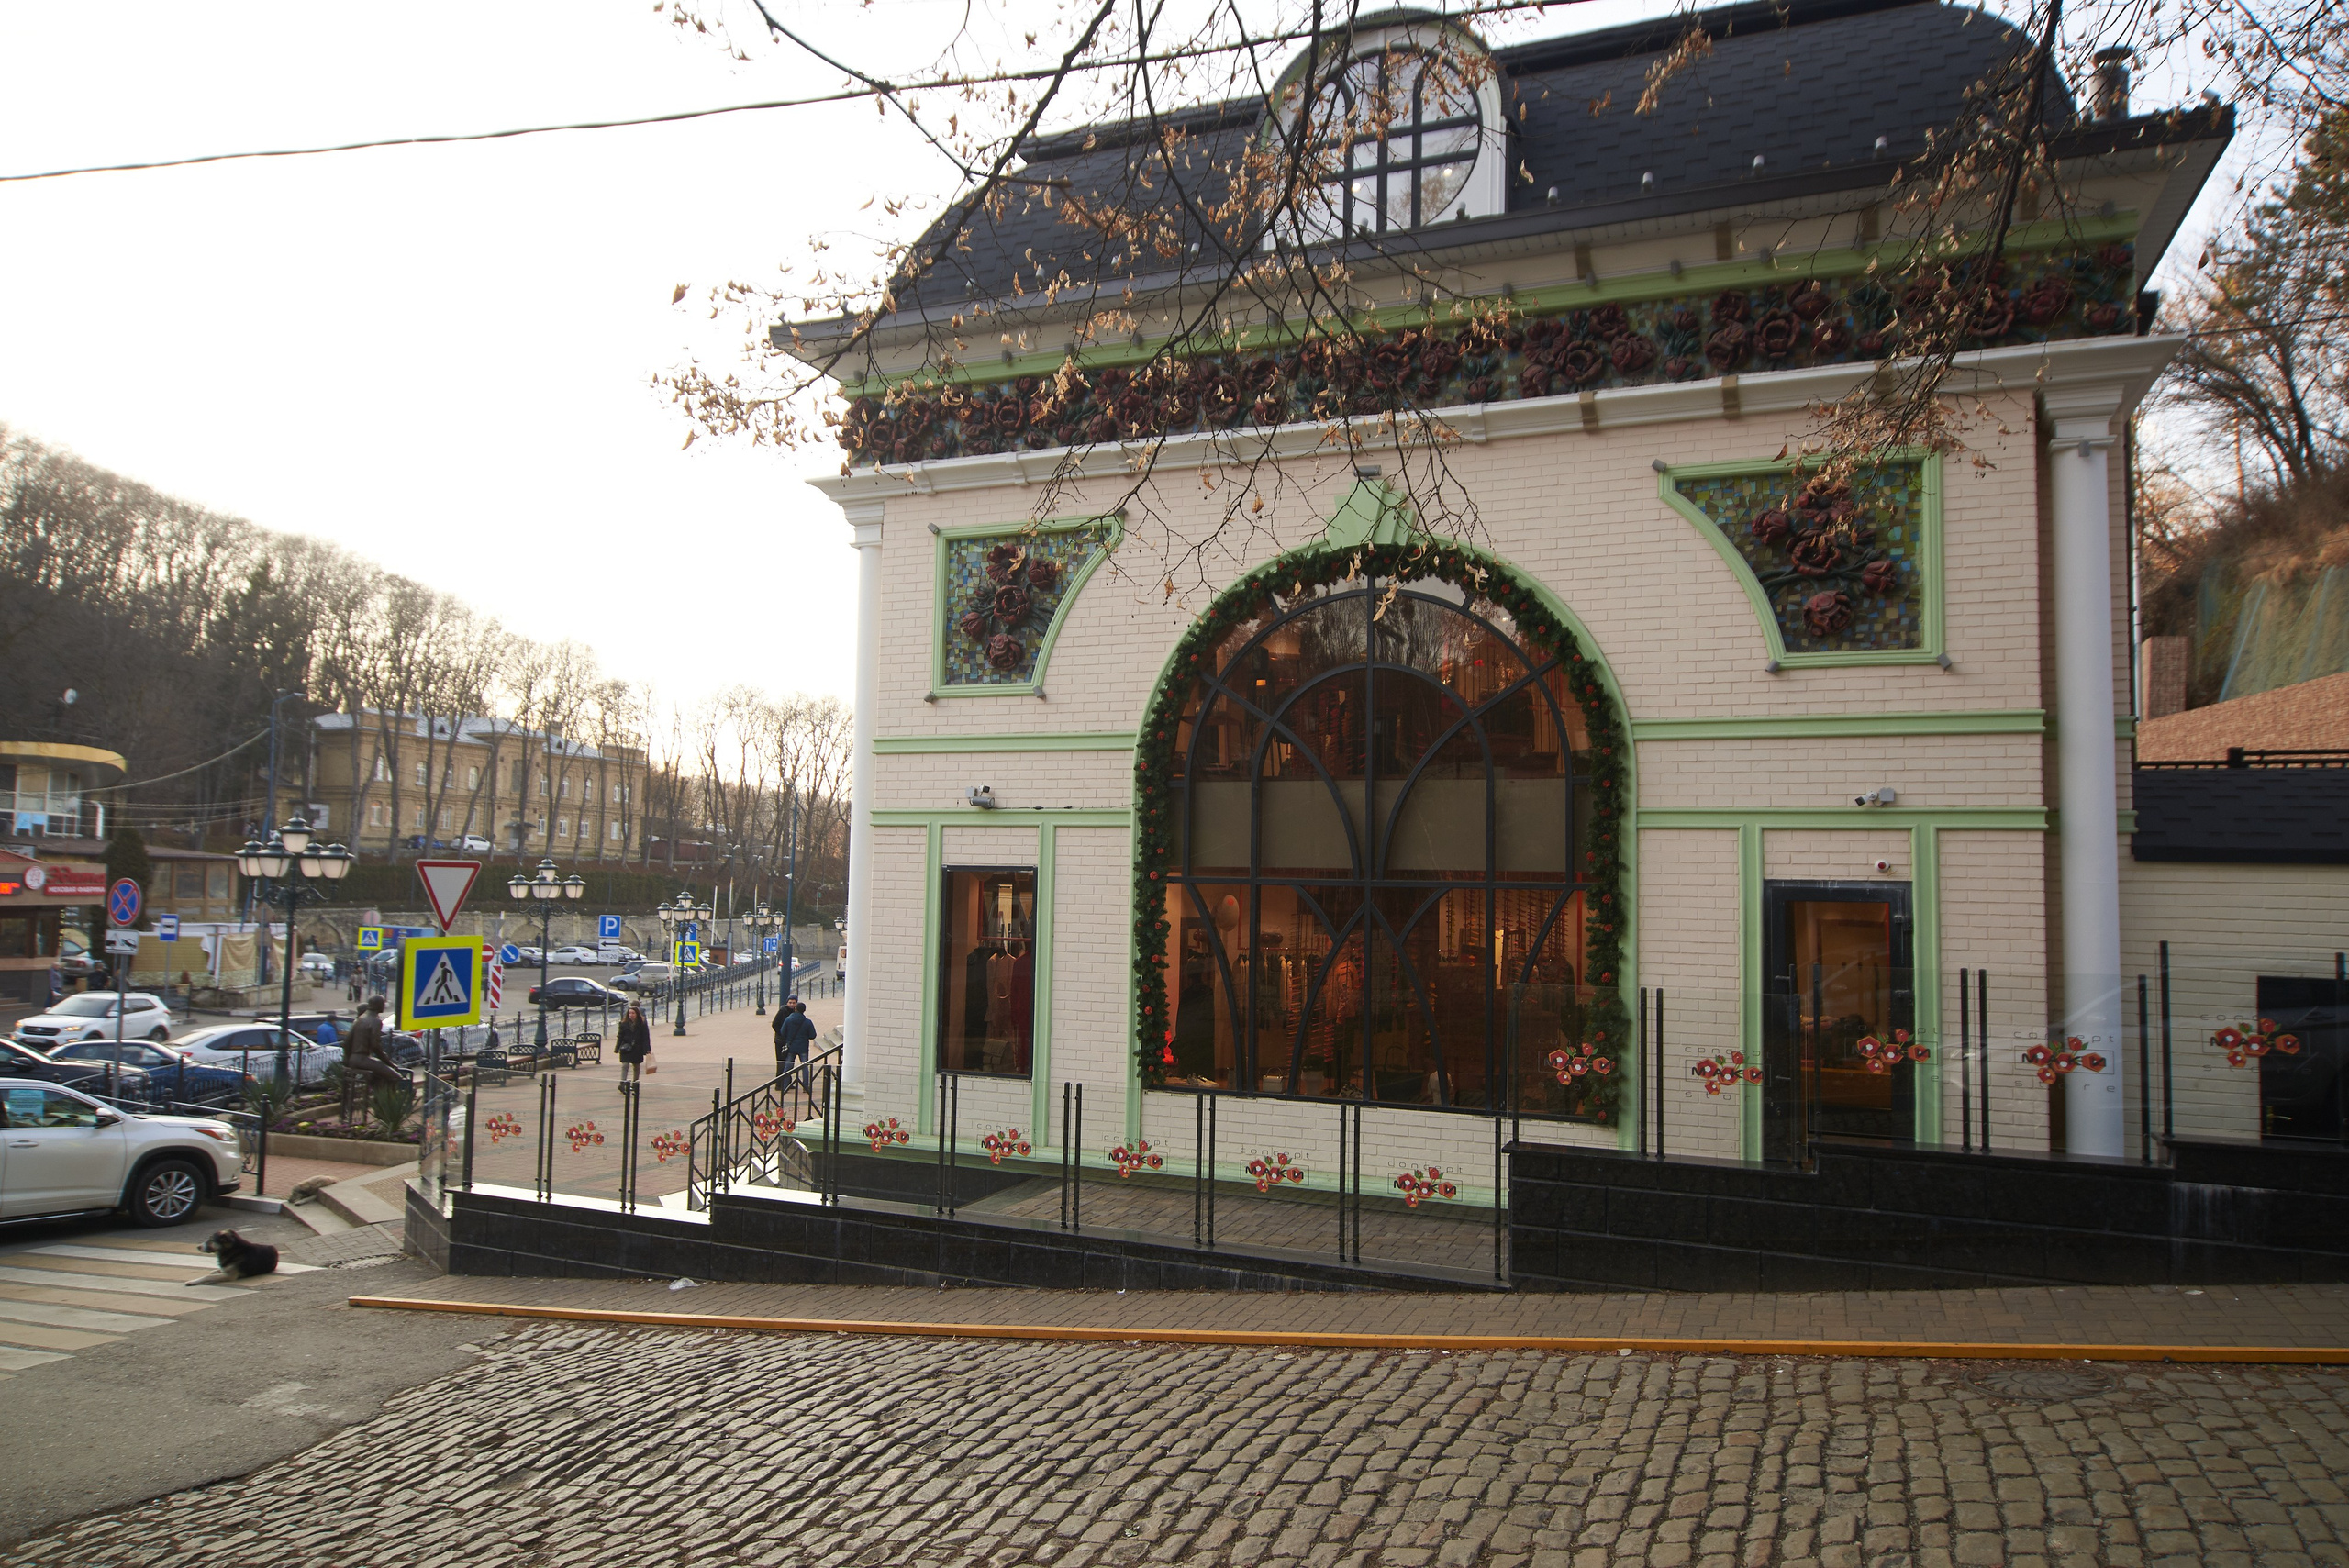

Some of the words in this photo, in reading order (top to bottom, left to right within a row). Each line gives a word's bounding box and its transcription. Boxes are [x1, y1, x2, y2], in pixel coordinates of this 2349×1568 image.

[605, 917, 618, 935] P
[981, 1140, 1031, 1153] МАКИ
[1108, 1152, 1163, 1166] МАКИ
[1245, 1166, 1304, 1179] МАКИ
[1394, 1180, 1457, 1195] МАКИ
